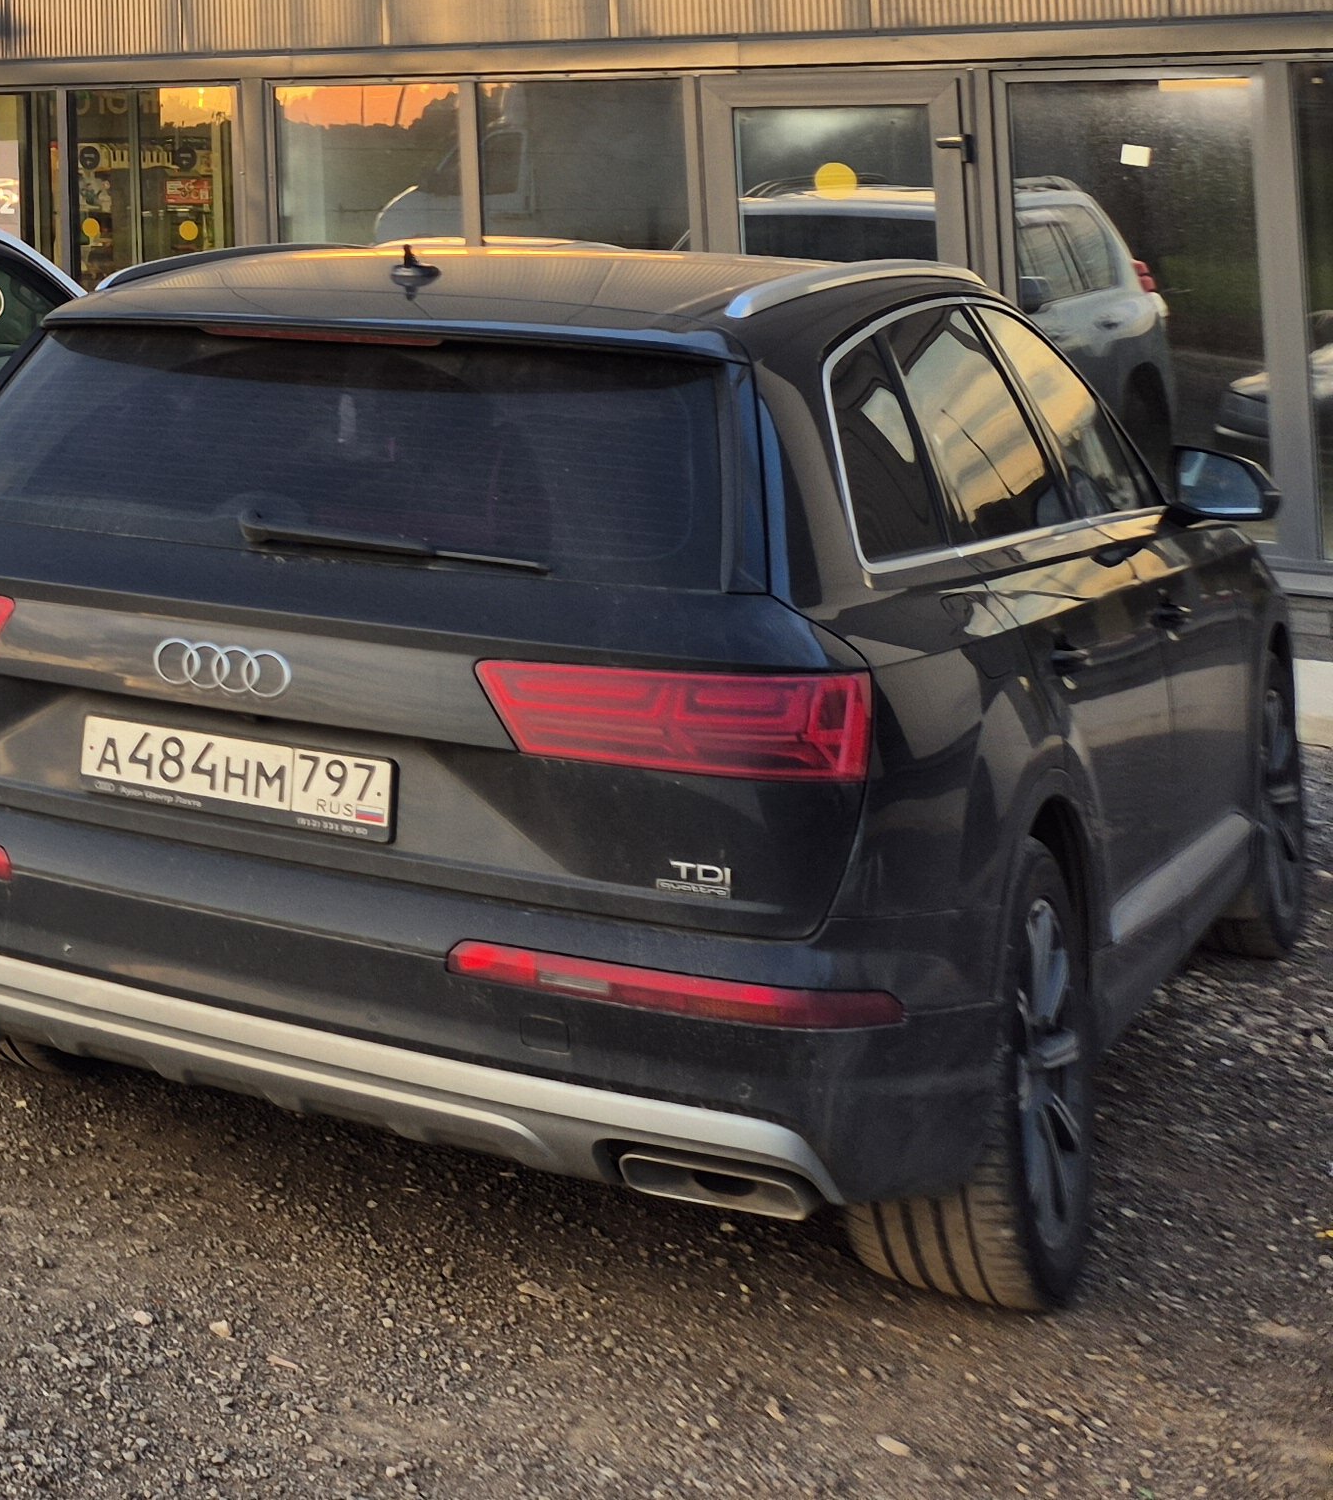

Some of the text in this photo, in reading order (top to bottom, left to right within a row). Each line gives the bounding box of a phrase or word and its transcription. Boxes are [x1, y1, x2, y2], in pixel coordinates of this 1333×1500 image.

[96, 732, 377, 804] А484НМ 797
[316, 797, 354, 818] RUS
[669, 859, 731, 885] TDI
